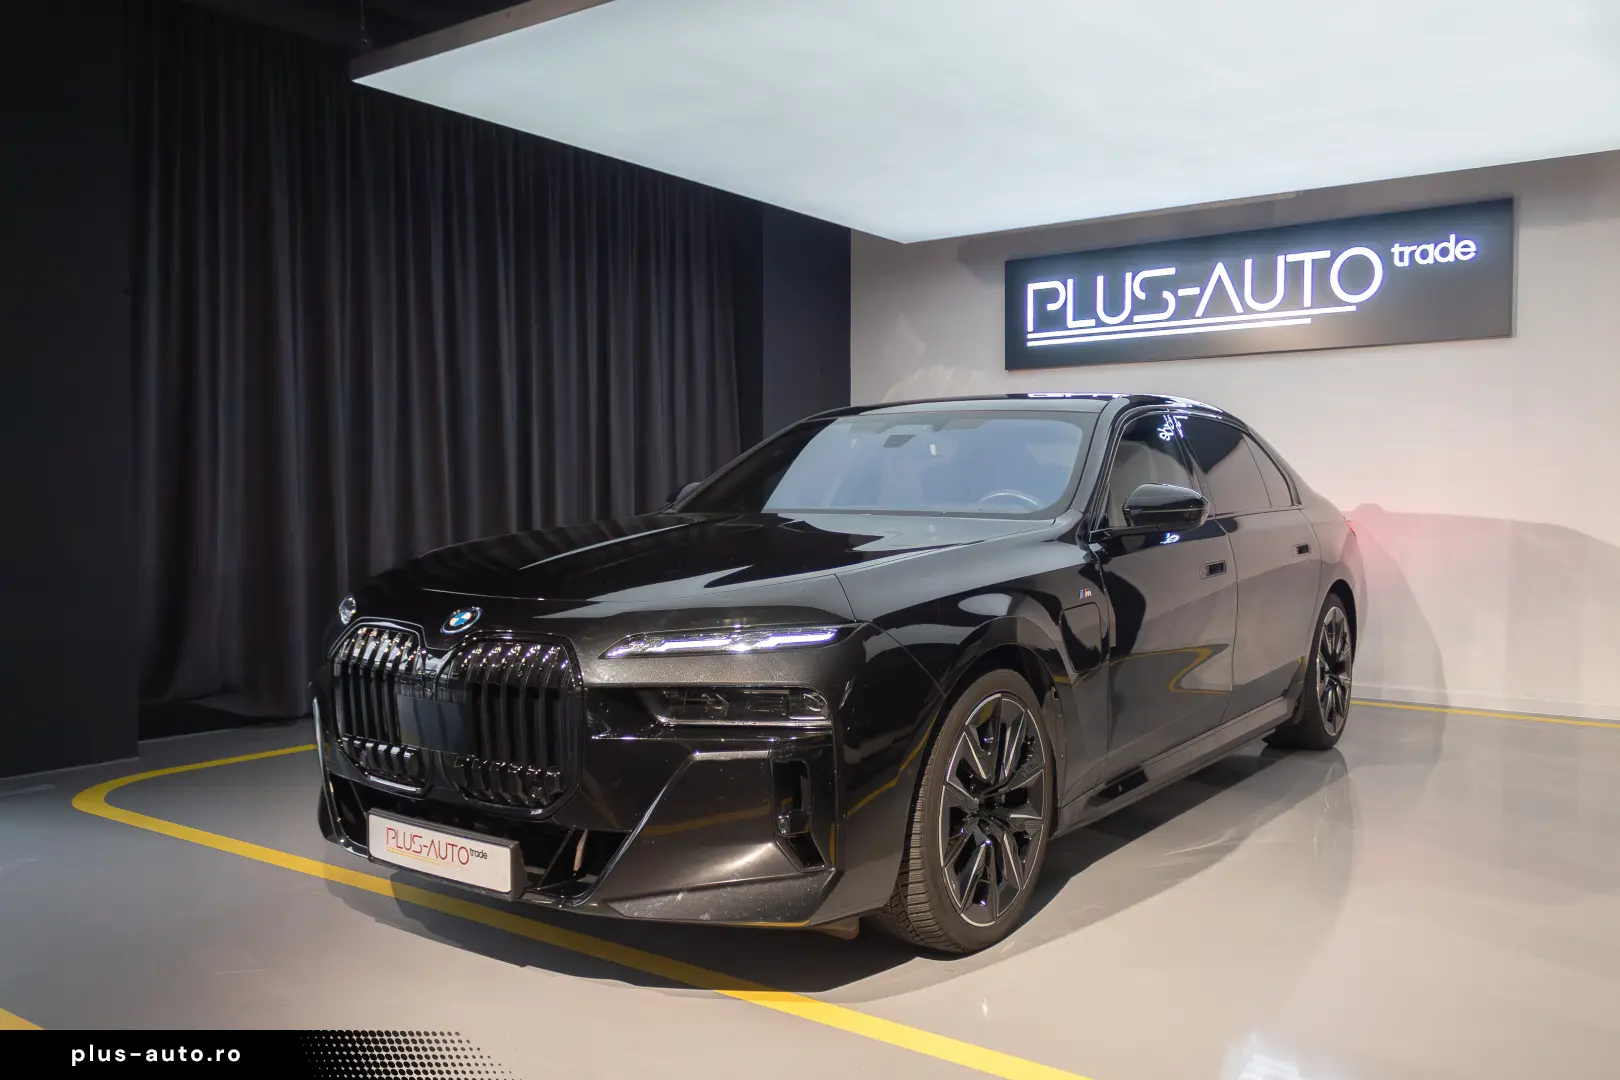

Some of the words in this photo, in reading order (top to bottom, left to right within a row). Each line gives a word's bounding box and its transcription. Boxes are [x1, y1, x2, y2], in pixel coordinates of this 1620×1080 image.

[1027, 246, 1383, 332] PLUS-AUTO
[1391, 232, 1477, 268] trade
[386, 827, 470, 865] PLUS-AUTO
[469, 847, 488, 860] trade
